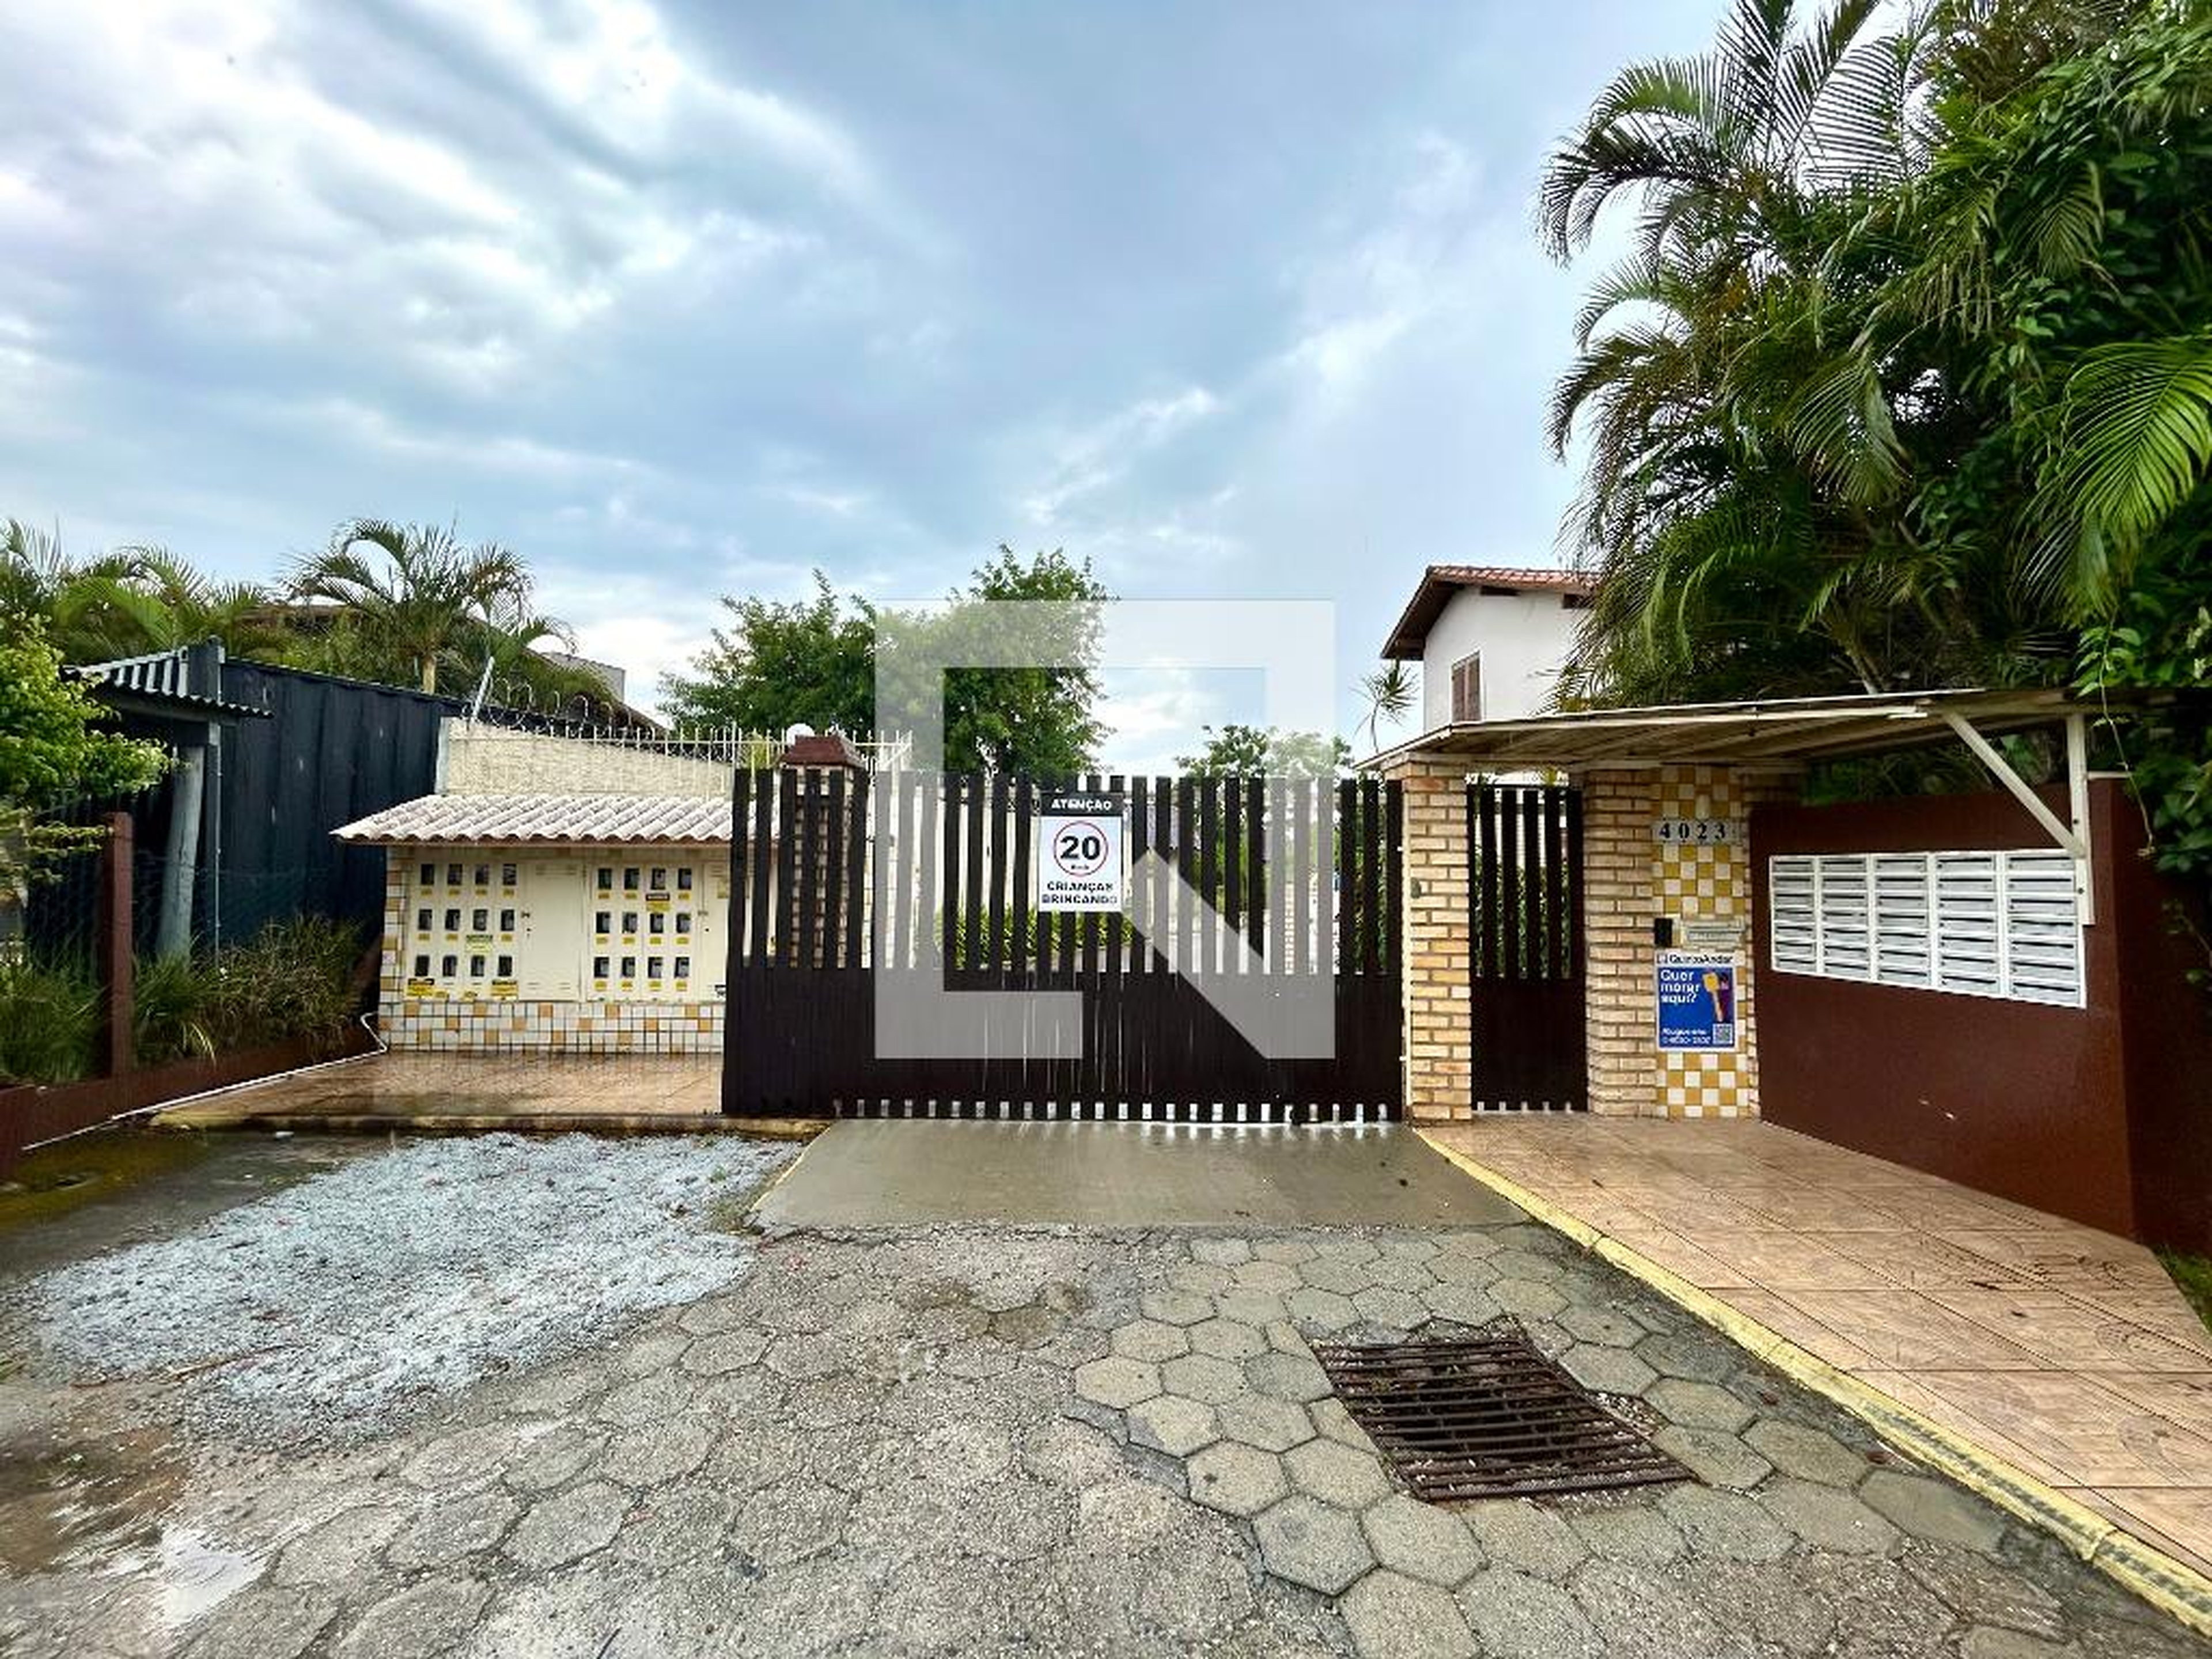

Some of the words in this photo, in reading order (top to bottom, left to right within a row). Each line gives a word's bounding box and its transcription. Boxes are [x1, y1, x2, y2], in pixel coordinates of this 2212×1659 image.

[1659, 823, 1726, 839] 4023
[1060, 836, 1101, 860] 20
[1660, 969, 1694, 981] Quer
